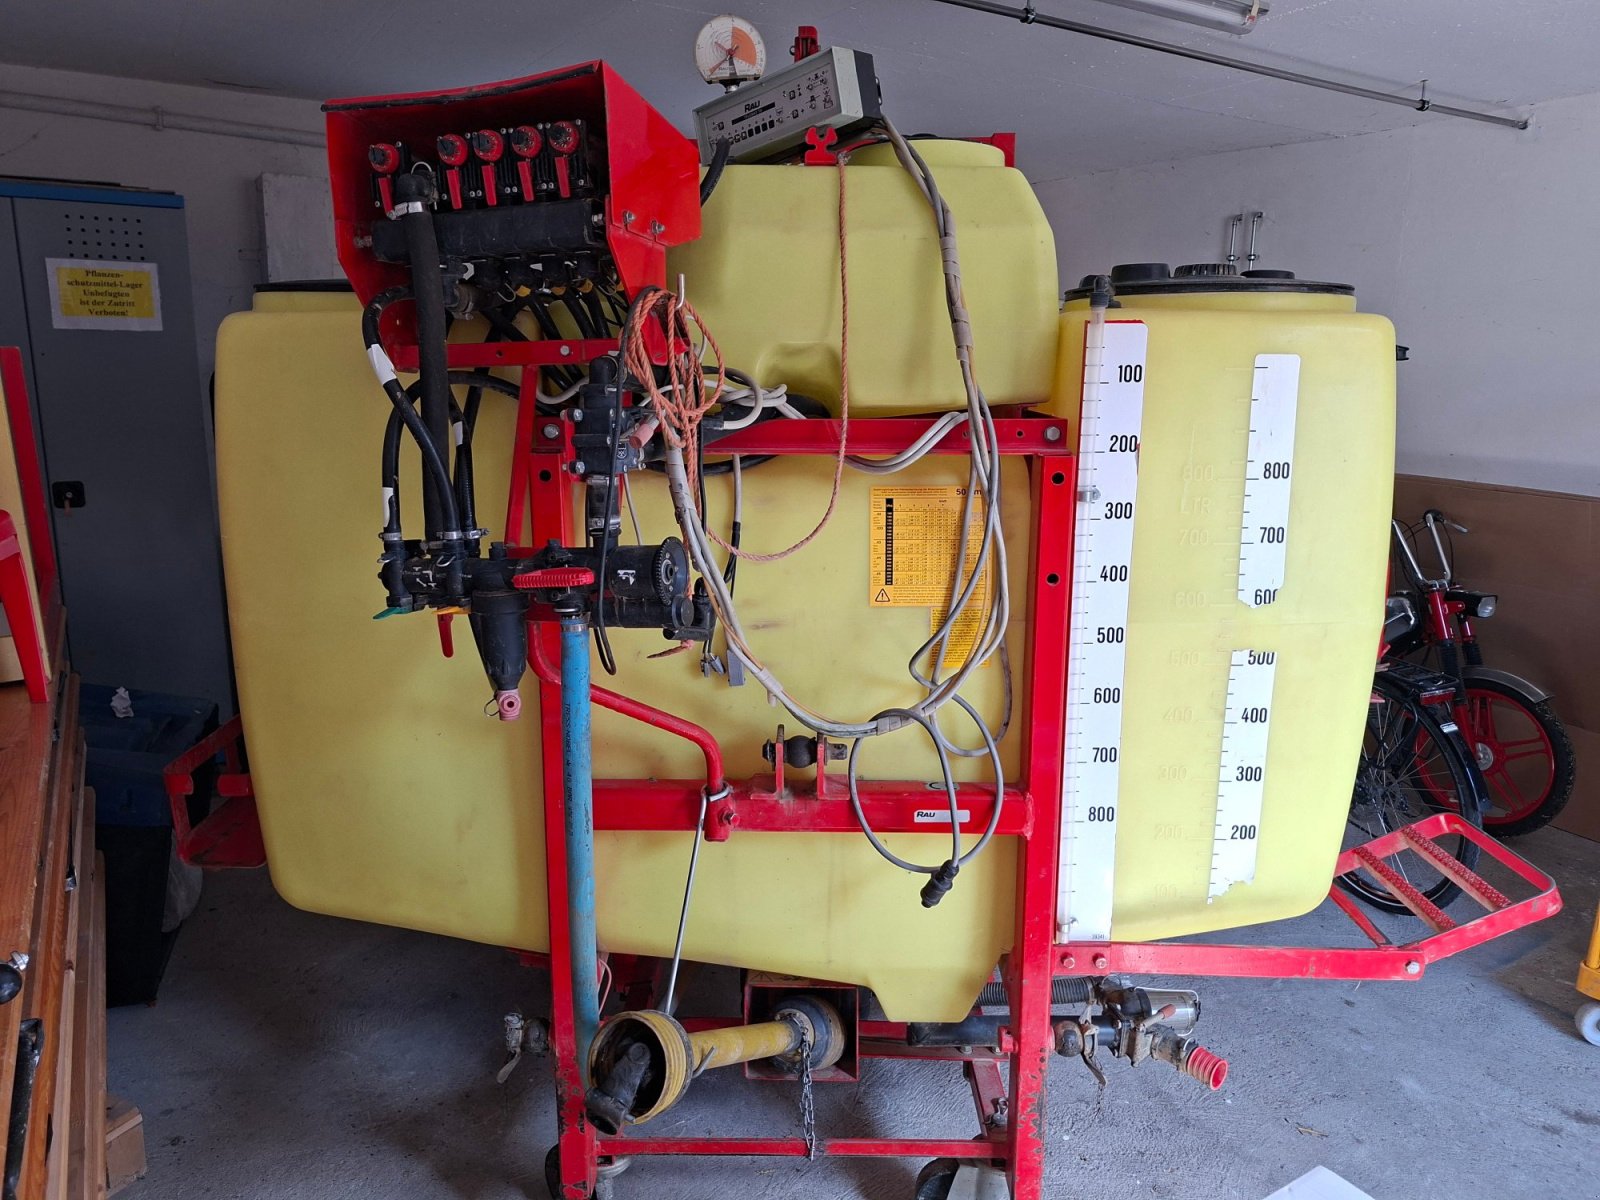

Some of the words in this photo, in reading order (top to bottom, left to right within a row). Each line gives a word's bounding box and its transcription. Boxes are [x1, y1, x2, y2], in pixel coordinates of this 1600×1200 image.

[744, 100, 761, 113] RAU
[85, 270, 124, 278] Pflanzen-
[67, 280, 143, 289] schutzmittel-Lager
[83, 289, 130, 298] Unbefugten
[107, 300, 135, 308] Zutritt
[88, 309, 128, 317] Verboten!
[1118, 364, 1143, 383] 100
[1109, 434, 1138, 453] 200
[1262, 462, 1290, 480] 800
[956, 488, 967, 496] 50
[1104, 502, 1133, 520] 300
[1259, 526, 1285, 544] 700
[1099, 565, 1128, 583] 400
[1096, 627, 1124, 644] 500
[1093, 687, 1121, 704] 600
[1241, 707, 1268, 723] 400
[1092, 747, 1118, 763] 700
[1235, 766, 1262, 782] 300
[1088, 806, 1115, 822] 800
[1230, 824, 1256, 840] 200
